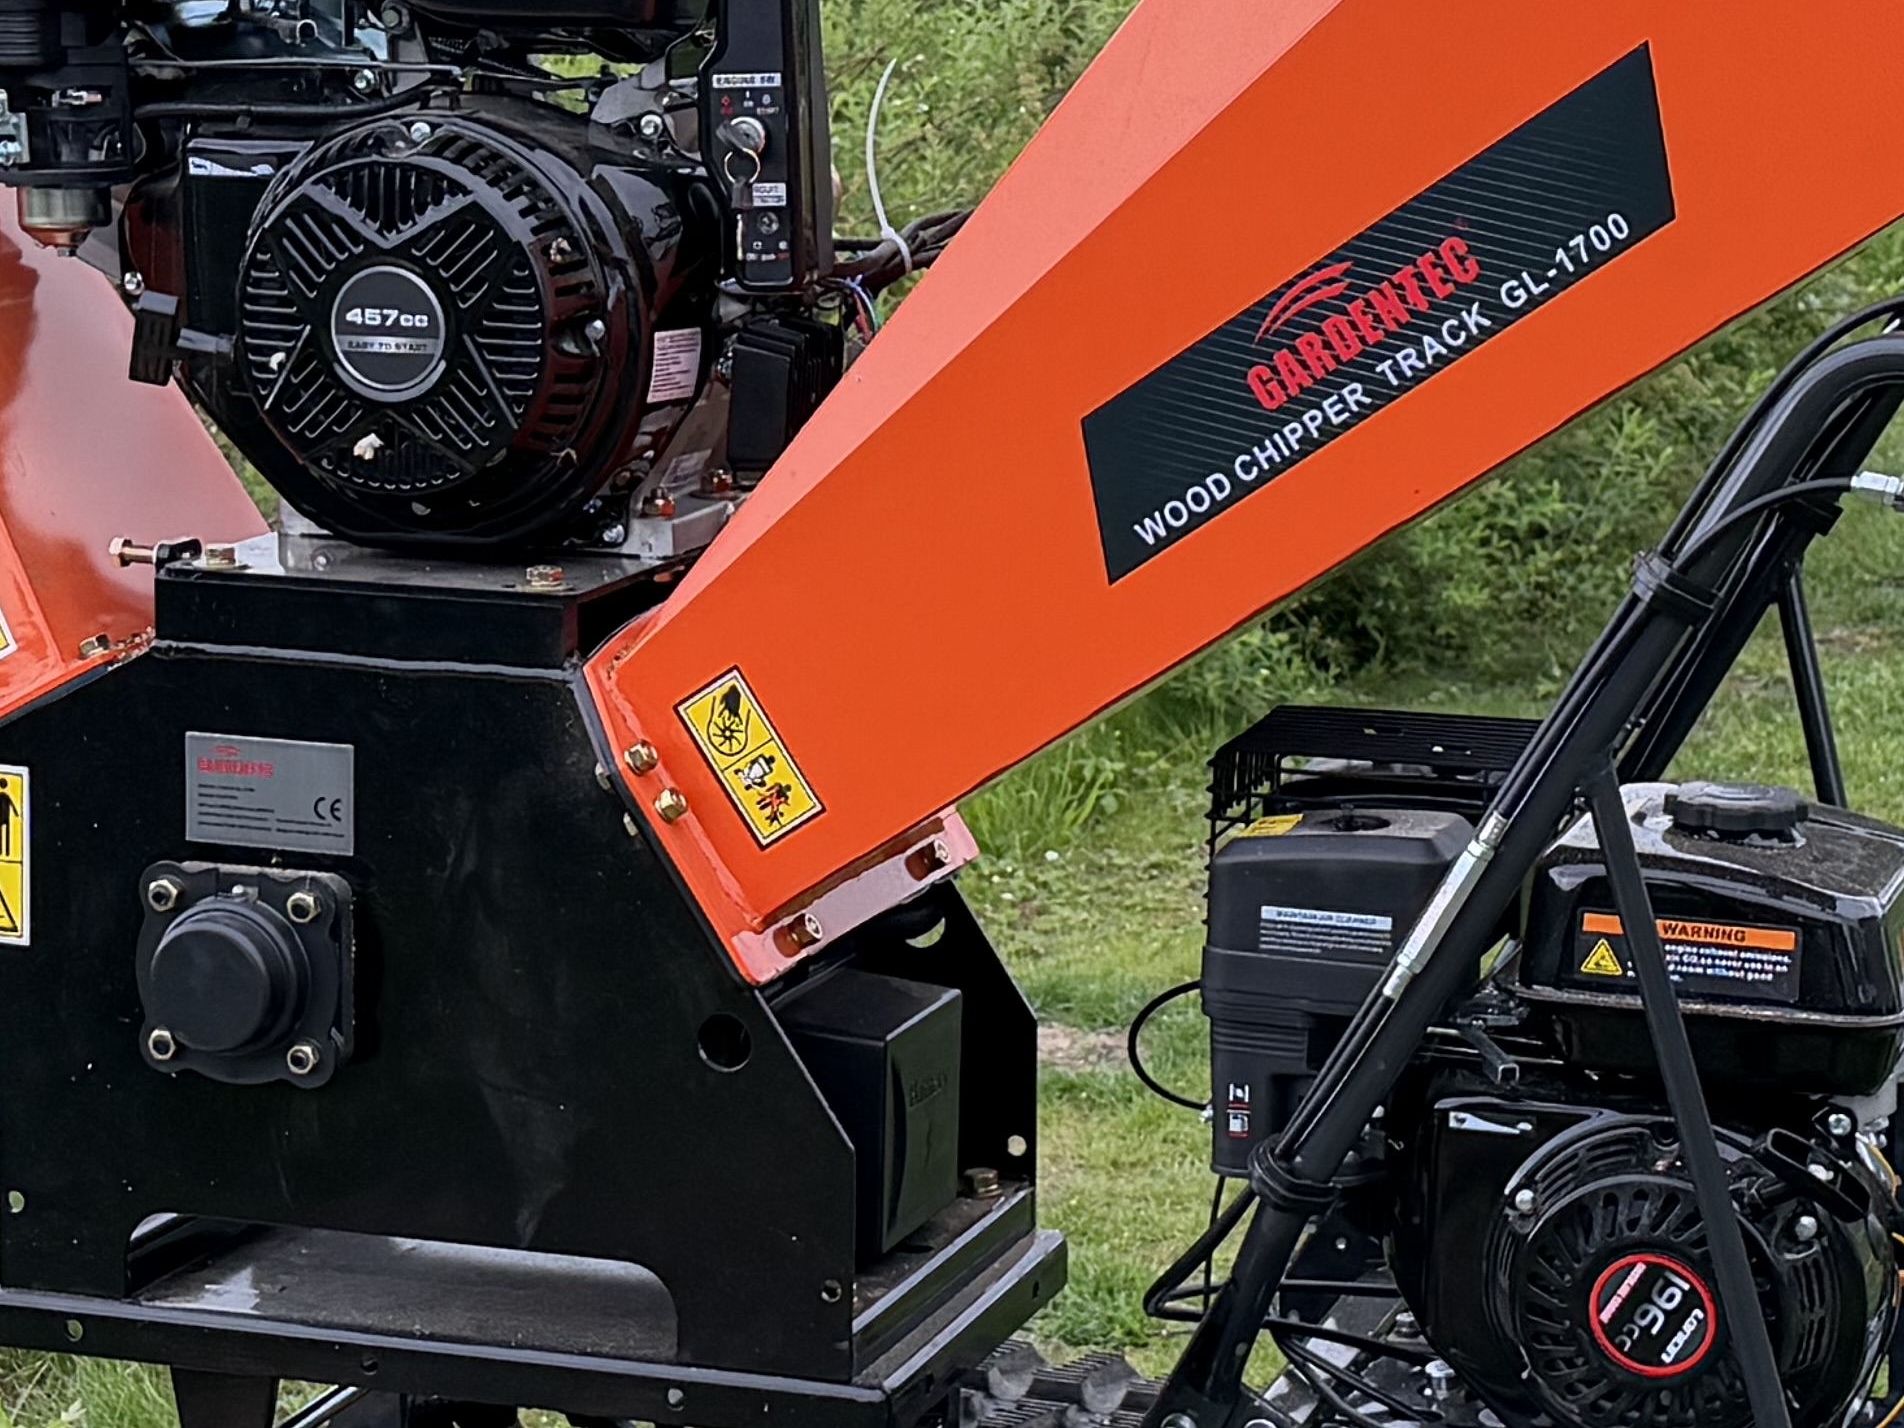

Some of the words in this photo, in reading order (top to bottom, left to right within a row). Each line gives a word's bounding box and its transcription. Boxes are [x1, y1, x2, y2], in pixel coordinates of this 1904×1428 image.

[345, 308, 429, 327] 457cc
[1245, 235, 1481, 411] GARDENTEC
[1133, 471, 1231, 546] WOOD
[1234, 382, 1372, 481] CHIPPER
[1375, 300, 1493, 388] TRACK
[1499, 211, 1631, 310] GL-1700
[313, 796, 342, 822] CE
[1661, 922, 1747, 943] WARNING
[1615, 1270, 1691, 1352] 196cc
